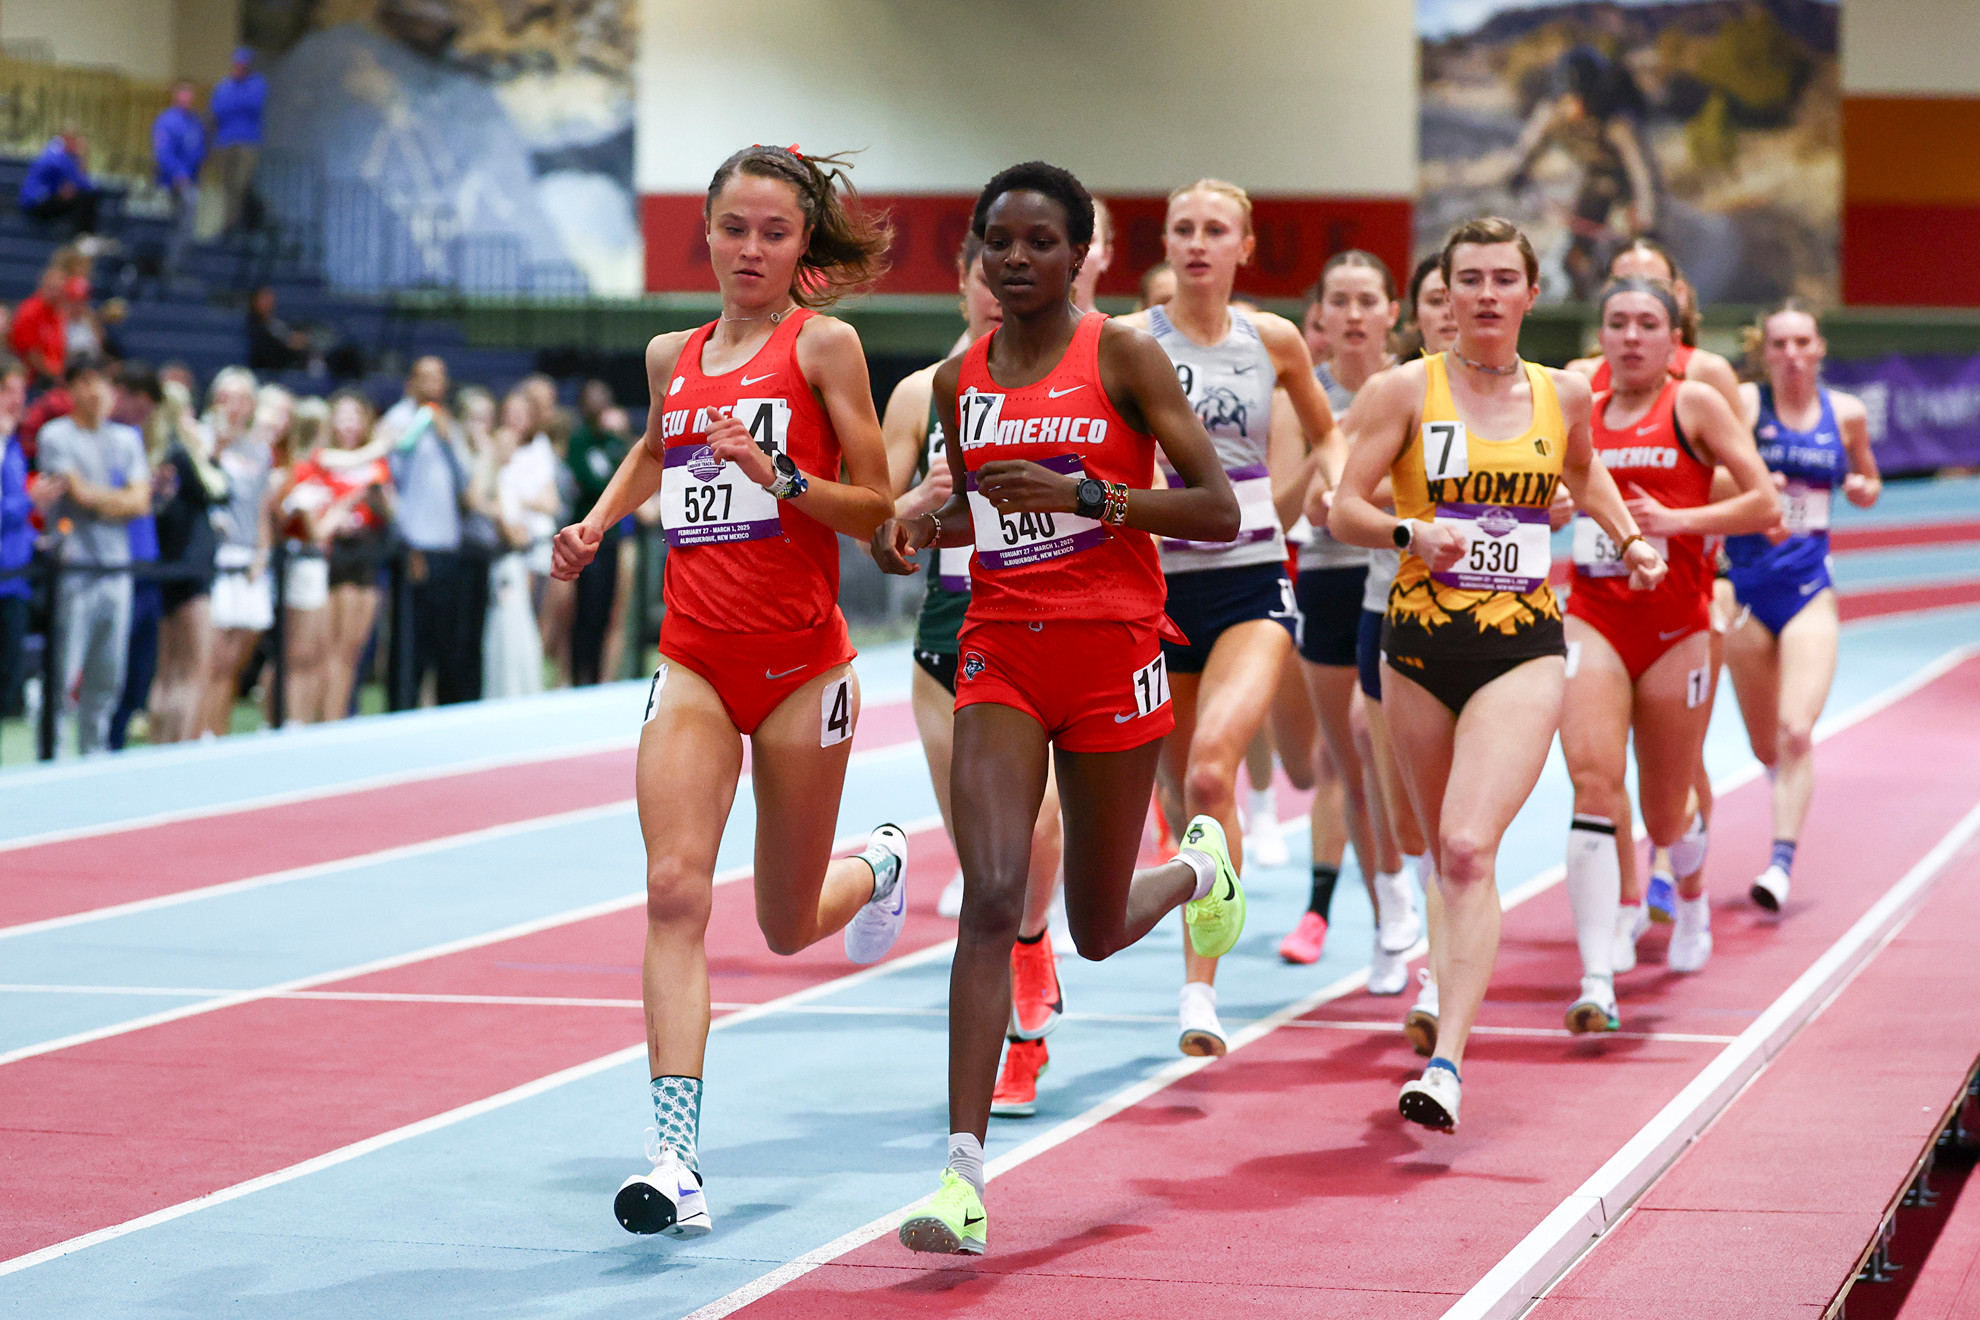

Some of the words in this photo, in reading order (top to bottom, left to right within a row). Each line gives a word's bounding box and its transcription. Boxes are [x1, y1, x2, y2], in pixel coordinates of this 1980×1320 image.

[662, 409, 690, 439] EW
[749, 403, 778, 456] 4
[963, 396, 997, 442] 17
[996, 417, 1108, 446] MEXICO
[1431, 425, 1455, 475] 7
[685, 483, 733, 523] 527
[1425, 471, 1562, 505] WYOMIN
[729, 532, 750, 540] MEXICO
[1000, 512, 1056, 545] 540
[1000, 550, 1022, 559] FEBRUARY
[1023, 547, 1030, 555] 27
[1034, 543, 1053, 552] MARCH
[1040, 551, 1053, 560] NEW
[1053, 545, 1074, 557] MEXICO
[1470, 541, 1519, 573] 530
[1138, 657, 1162, 713] 17
[827, 681, 849, 738] 4
